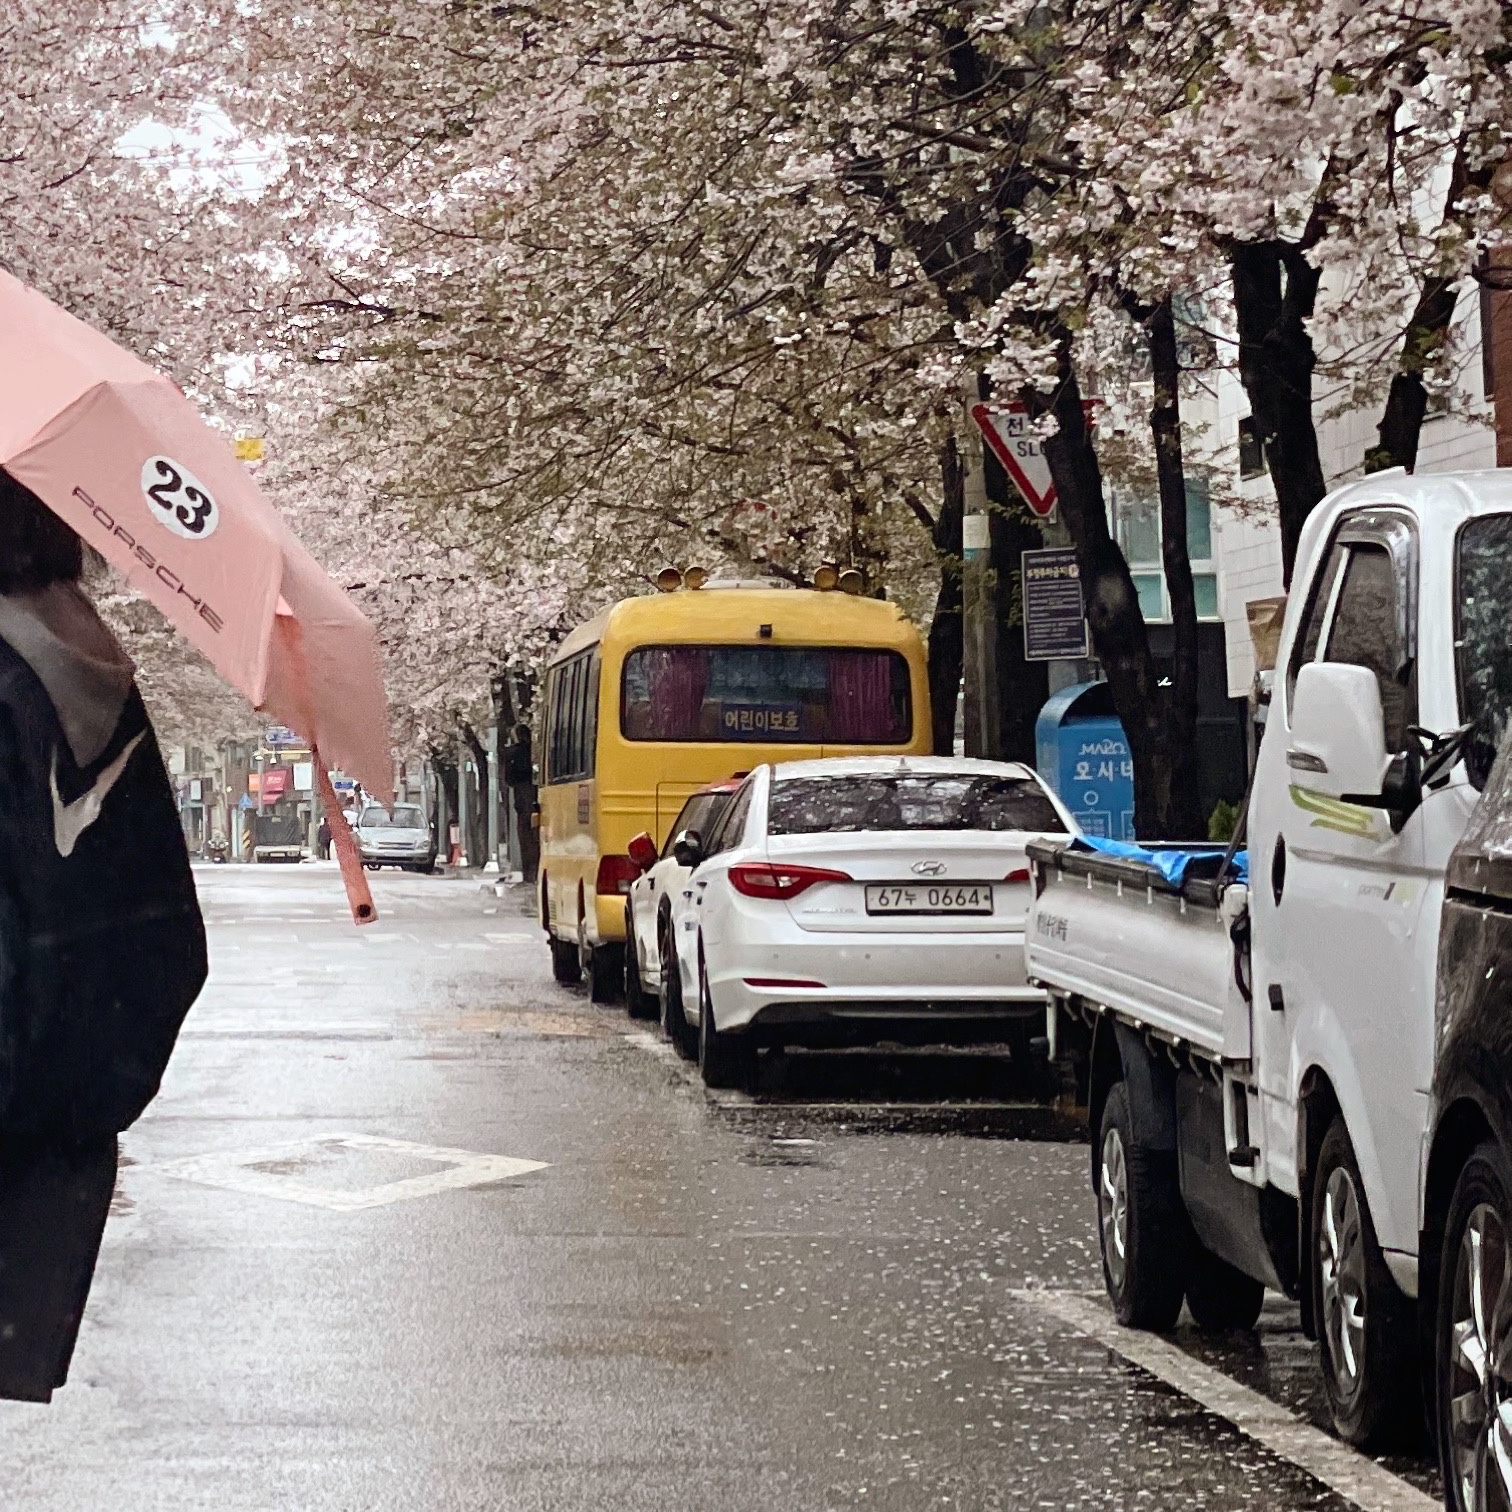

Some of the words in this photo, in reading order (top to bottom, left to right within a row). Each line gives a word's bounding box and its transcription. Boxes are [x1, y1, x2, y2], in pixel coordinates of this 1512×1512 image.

[1017, 441, 1044, 457] SL
[148, 460, 212, 533] 23
[72, 485, 224, 634] PORSCHE
[725, 709, 799, 731] 어린이보호
[1078, 738, 1127, 756] MAPO
[878, 889, 917, 907] 67누
[928, 889, 980, 907] 0664
